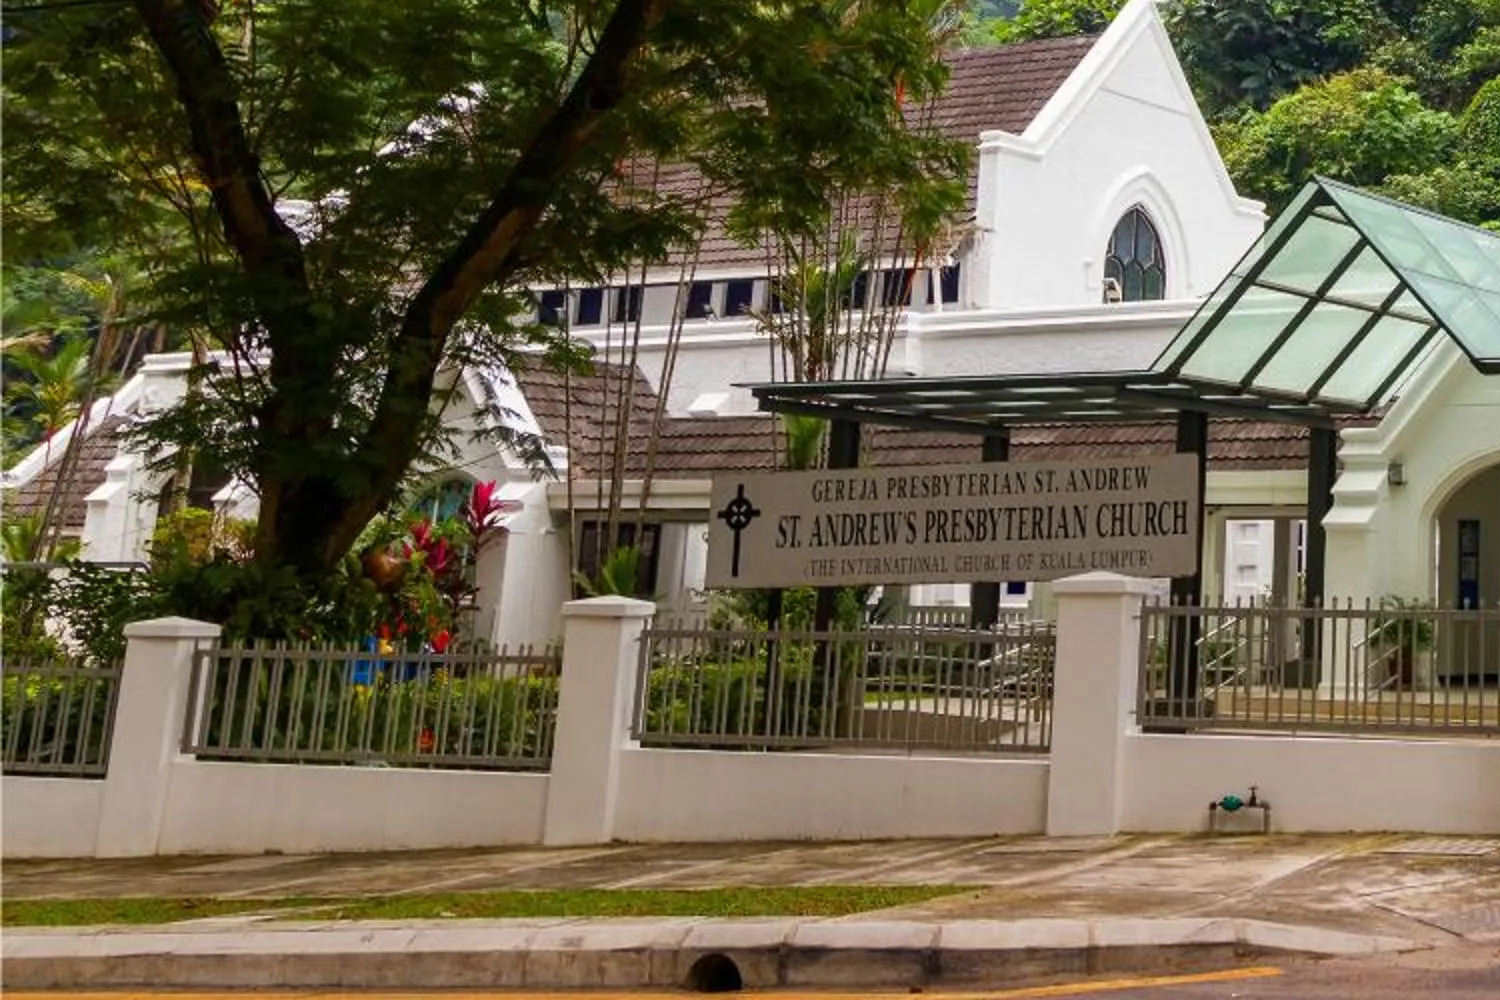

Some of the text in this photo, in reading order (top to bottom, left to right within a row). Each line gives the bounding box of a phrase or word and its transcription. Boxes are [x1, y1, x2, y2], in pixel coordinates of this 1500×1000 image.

[812, 465, 1151, 503] GEREJA PRESBYTERIAN ST. ANDREW
[775, 500, 1188, 549] ST. ANDREW'S PRESBYTERIAN CHURCH
[841, 554, 949, 575] INTERNATIONAL
[955, 553, 1011, 574] CHURCH
[1017, 553, 1032, 570] OF
